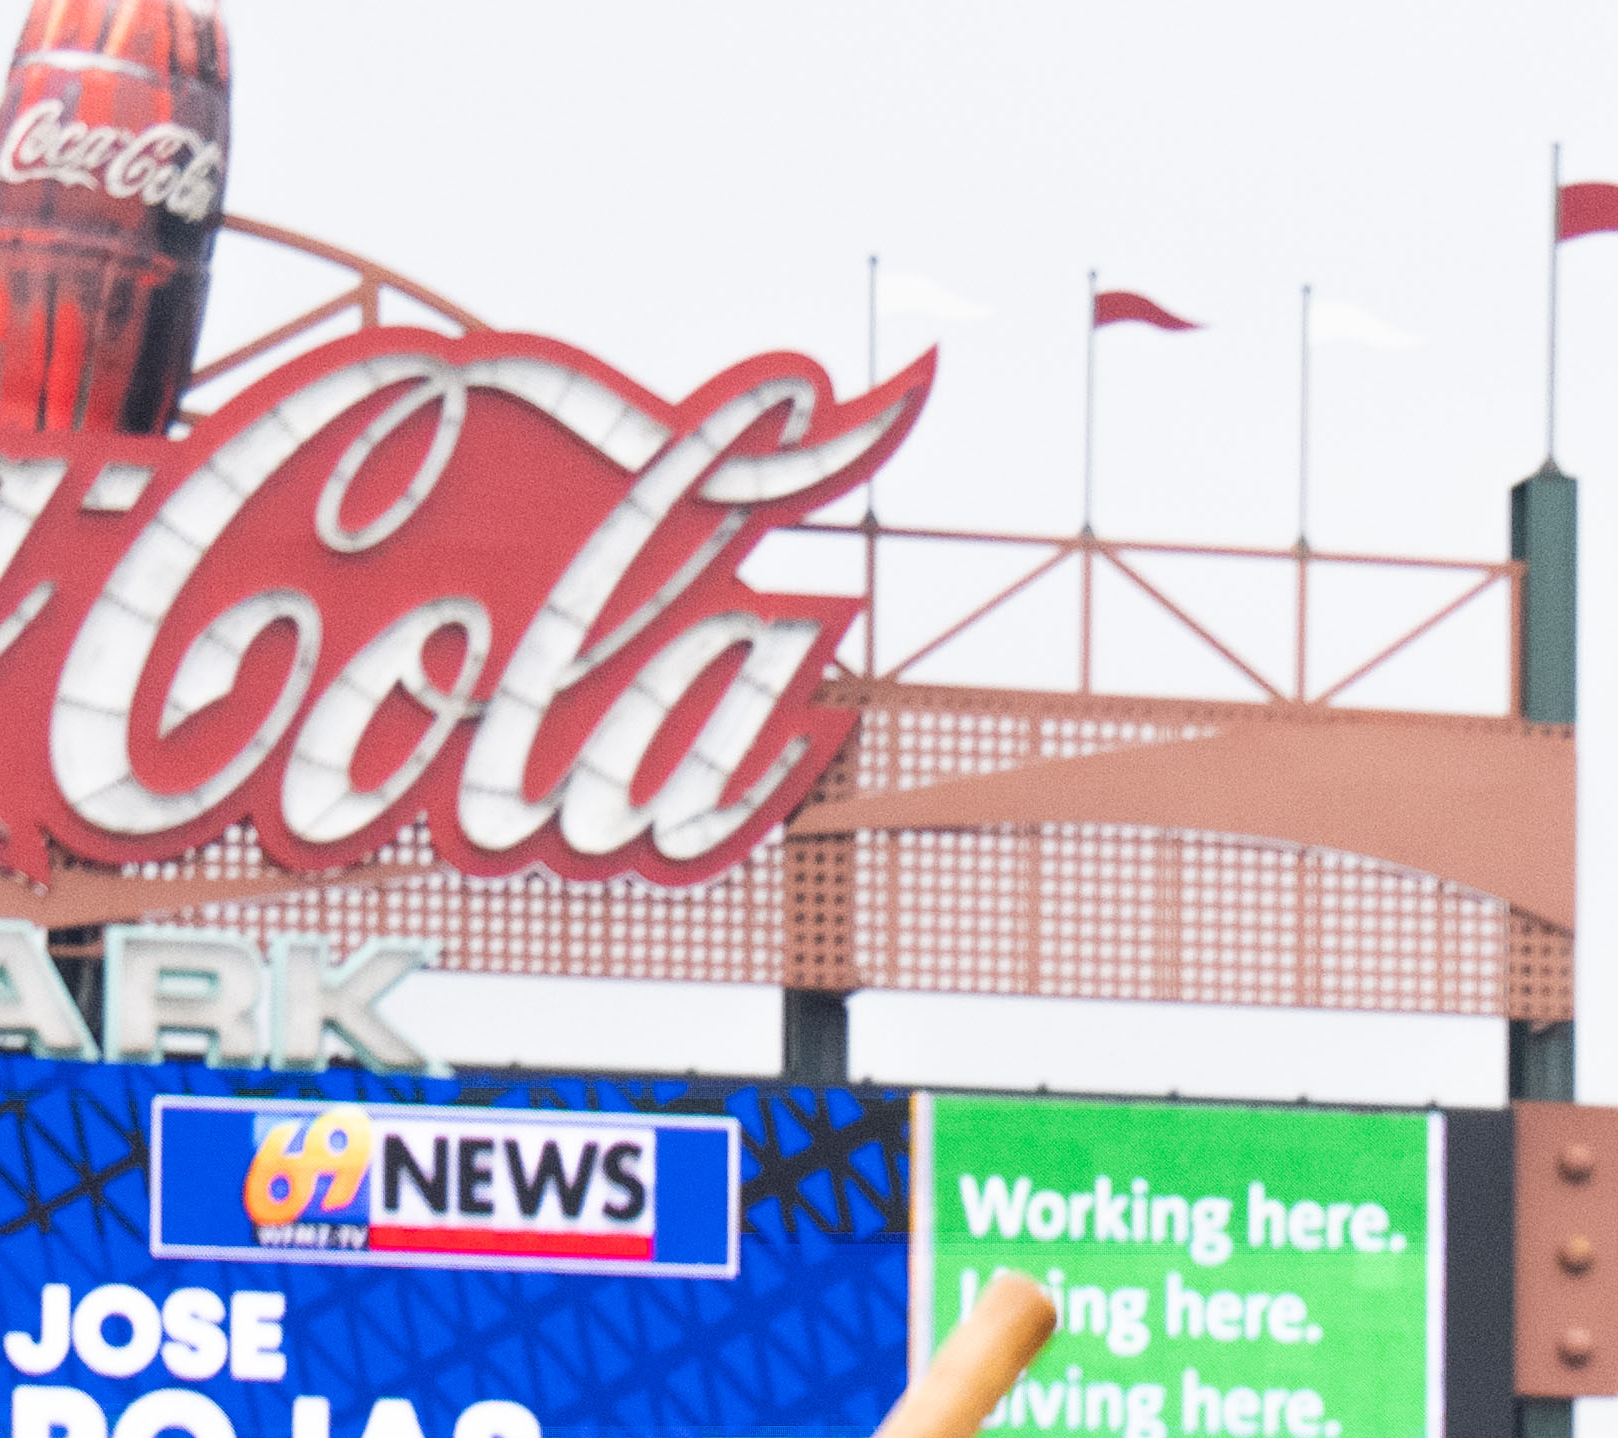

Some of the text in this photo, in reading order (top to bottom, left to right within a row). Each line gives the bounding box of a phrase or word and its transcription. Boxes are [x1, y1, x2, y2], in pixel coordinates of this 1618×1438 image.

[243, 1105, 647, 1226] 69 NEWS
[958, 1174, 1408, 1267] Working here.
[2, 1282, 288, 1381] JOSE
[959, 1266, 1324, 1357] ing here.
